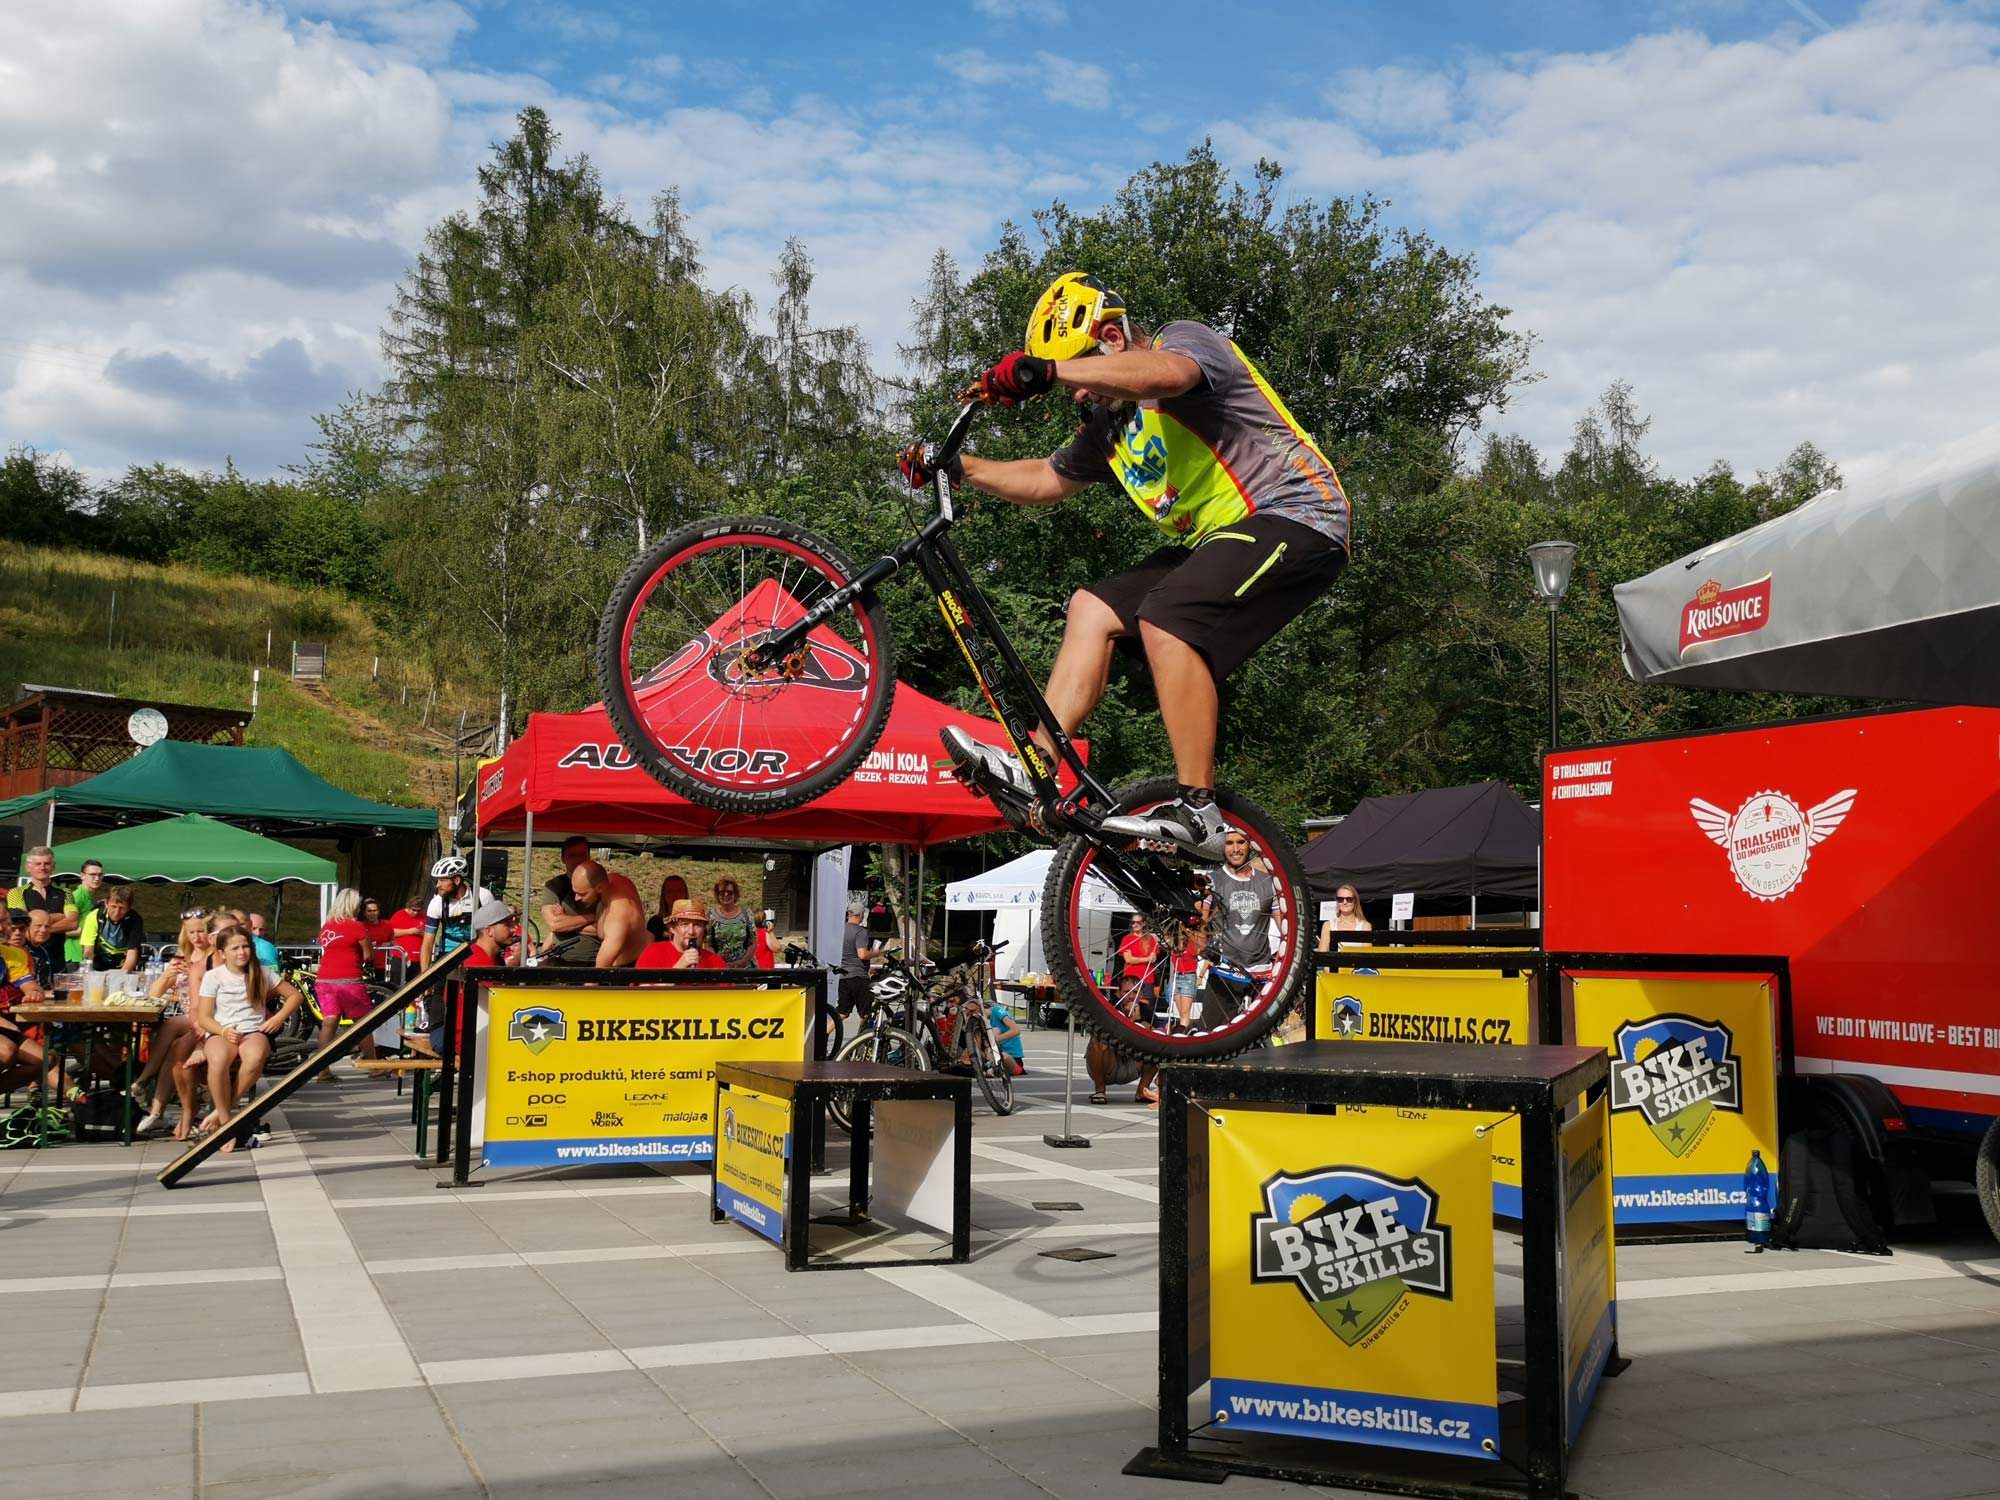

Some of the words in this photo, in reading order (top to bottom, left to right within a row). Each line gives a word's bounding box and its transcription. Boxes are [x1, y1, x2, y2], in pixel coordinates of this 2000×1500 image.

[1687, 596, 1762, 638] KRUŠOVICE
[656, 757, 788, 801] SCHWALBE
[854, 771, 882, 782] REZEK
[888, 772, 928, 785] REZKOVÁ
[897, 753, 928, 772] KOLA
[1734, 823, 1801, 852] TRIALSHOW
[1736, 850, 1747, 861] DO
[1747, 841, 1792, 858] IMPOSSIBLE
[1740, 864, 1751, 881] FUN
[1752, 877, 1761, 888] ON
[1763, 863, 1798, 890] OBSTACLES
[1277, 885, 1305, 1004] SCHWALBE
[577, 1017, 785, 1042] BIKESKILLS.CZ
[1368, 1012, 1513, 1045] BIKESKILLS.CZ
[1816, 1016, 1834, 1035] WE
[1837, 1017, 1852, 1037] DO
[1855, 1019, 1866, 1038] IT
[1868, 1019, 1900, 1041] WITH
[1902, 1022, 1934, 1044] LOVE
[1948, 1025, 1981, 1047] BEST
[507, 1071, 556, 1084] E-shop
[559, 1068, 627, 1083] produktů,
[630, 1068, 666, 1081] které
[669, 1068, 703, 1080] sami
[1620, 1036, 1715, 1105] BIKE
[1653, 1066, 1732, 1119] SKILLS
[662, 1112, 699, 1123] maloja
[556, 1141, 713, 1158] www.bikeskills.cz/sh
[736, 1122, 784, 1159] BIKESKILLS.CZ
[1685, 1116, 1716, 1159] bikeskills.cz
[1613, 1188, 1747, 1208] www.bikeskills.cz
[1269, 1196, 1409, 1275] BIKE
[1317, 1237, 1435, 1295] SKILLS
[1360, 1298, 1410, 1350] bikeskills.cz
[1230, 1395, 1471, 1440] www.bikeskills.cz
